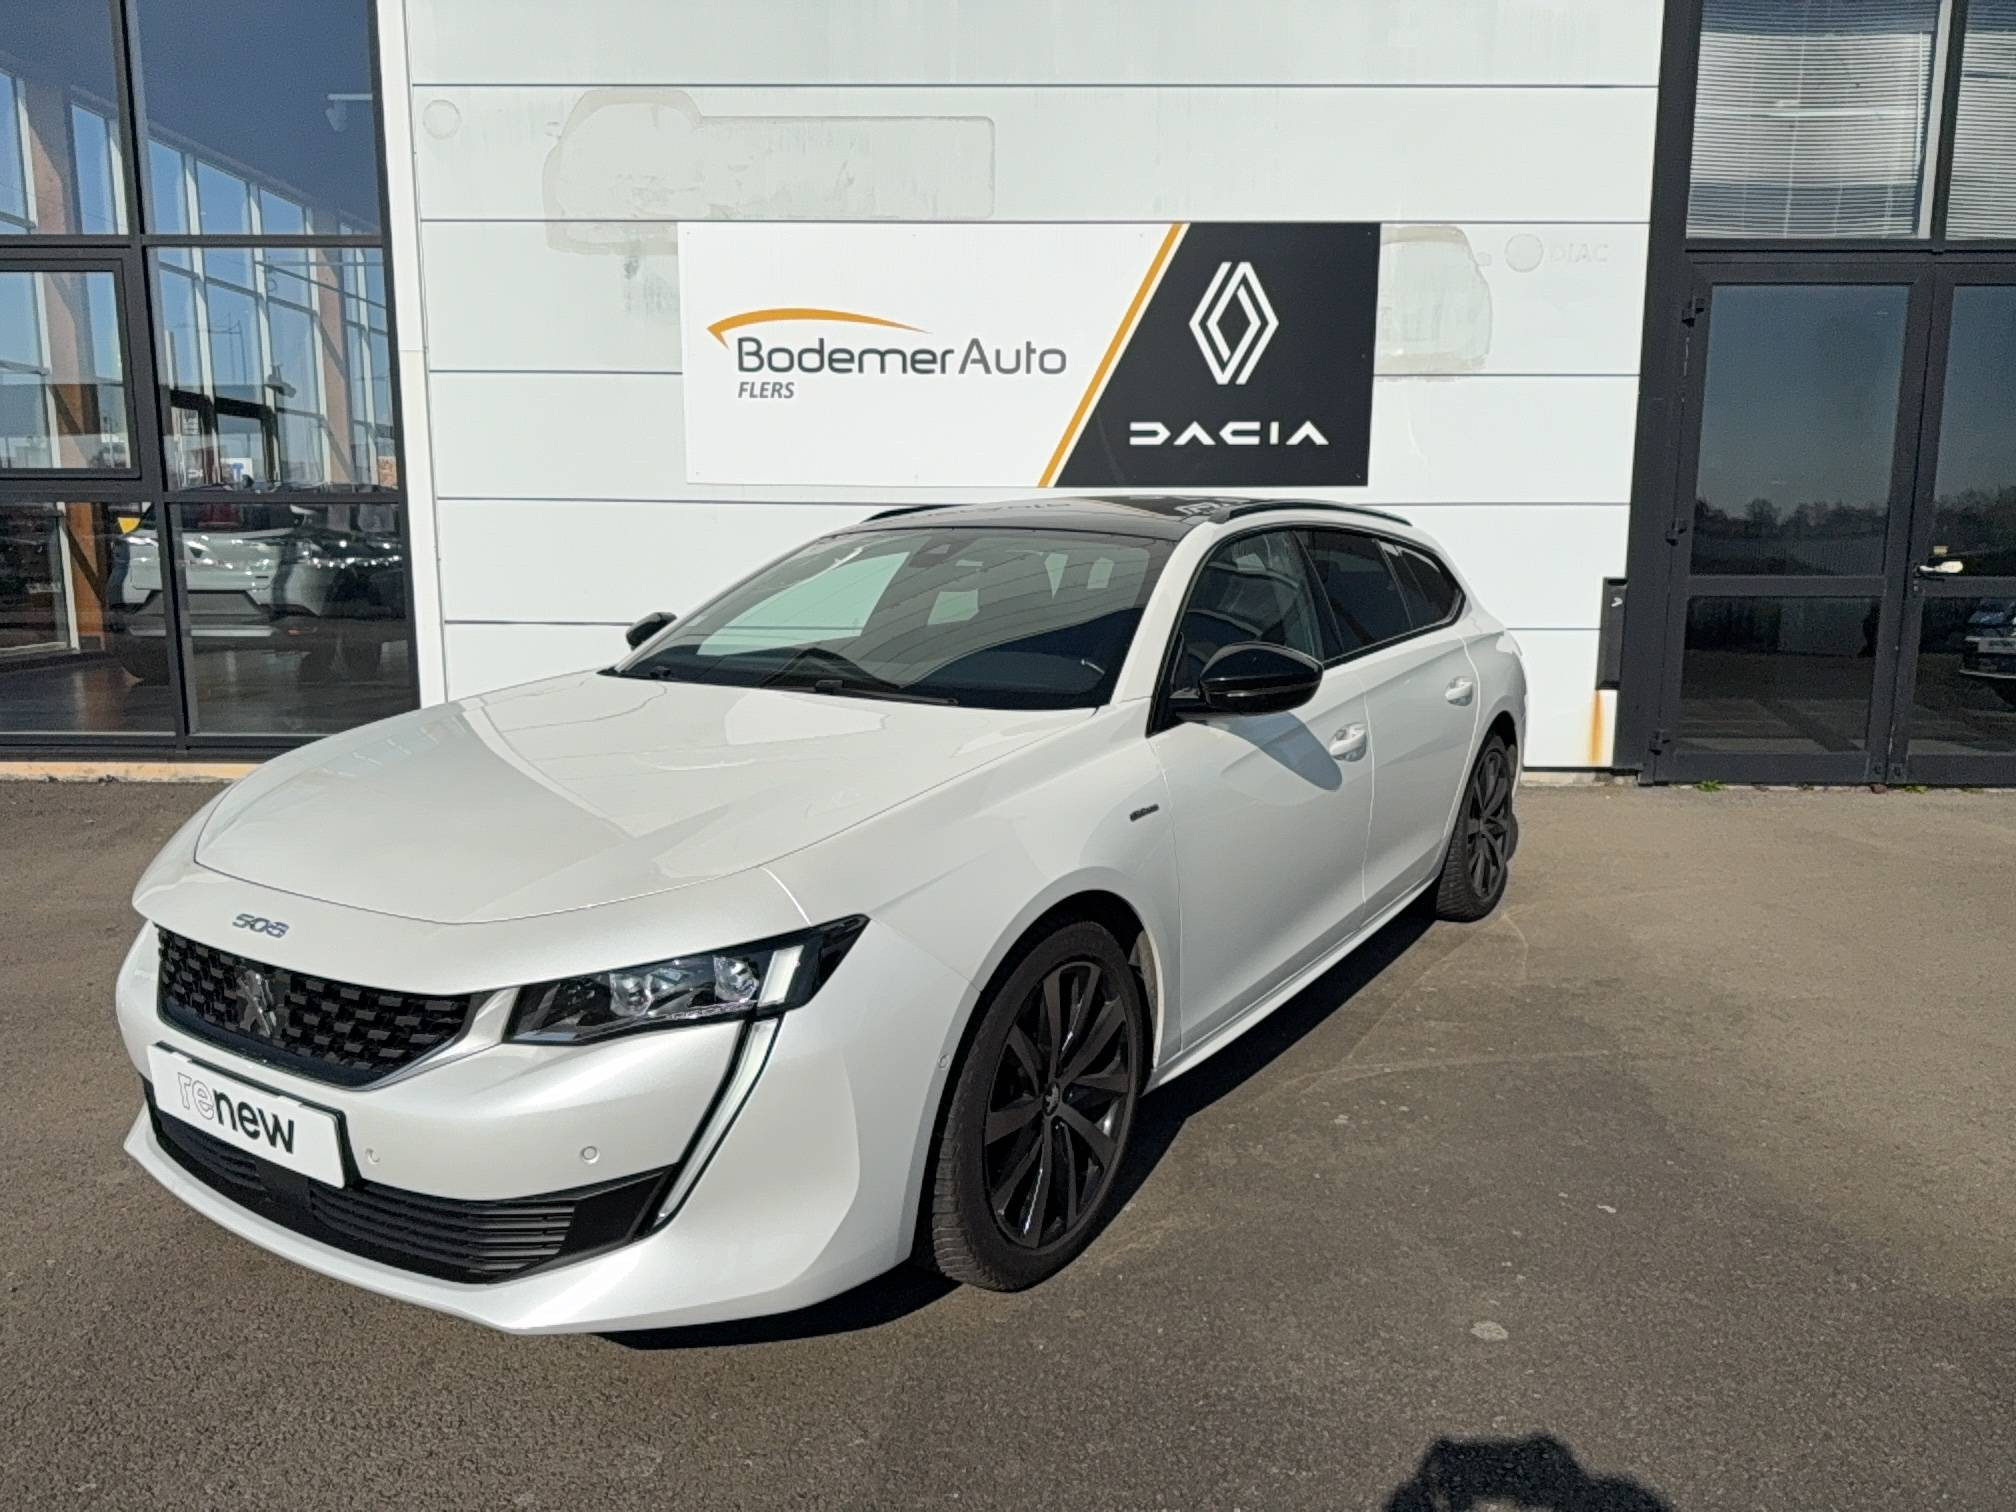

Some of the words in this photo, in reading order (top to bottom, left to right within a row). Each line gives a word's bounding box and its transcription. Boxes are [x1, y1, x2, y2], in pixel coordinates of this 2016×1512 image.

[737, 381, 795, 399] FLERS
[1129, 420, 1329, 446] DACIA
[232, 913, 289, 938] 508
[177, 1072, 294, 1153] renew
